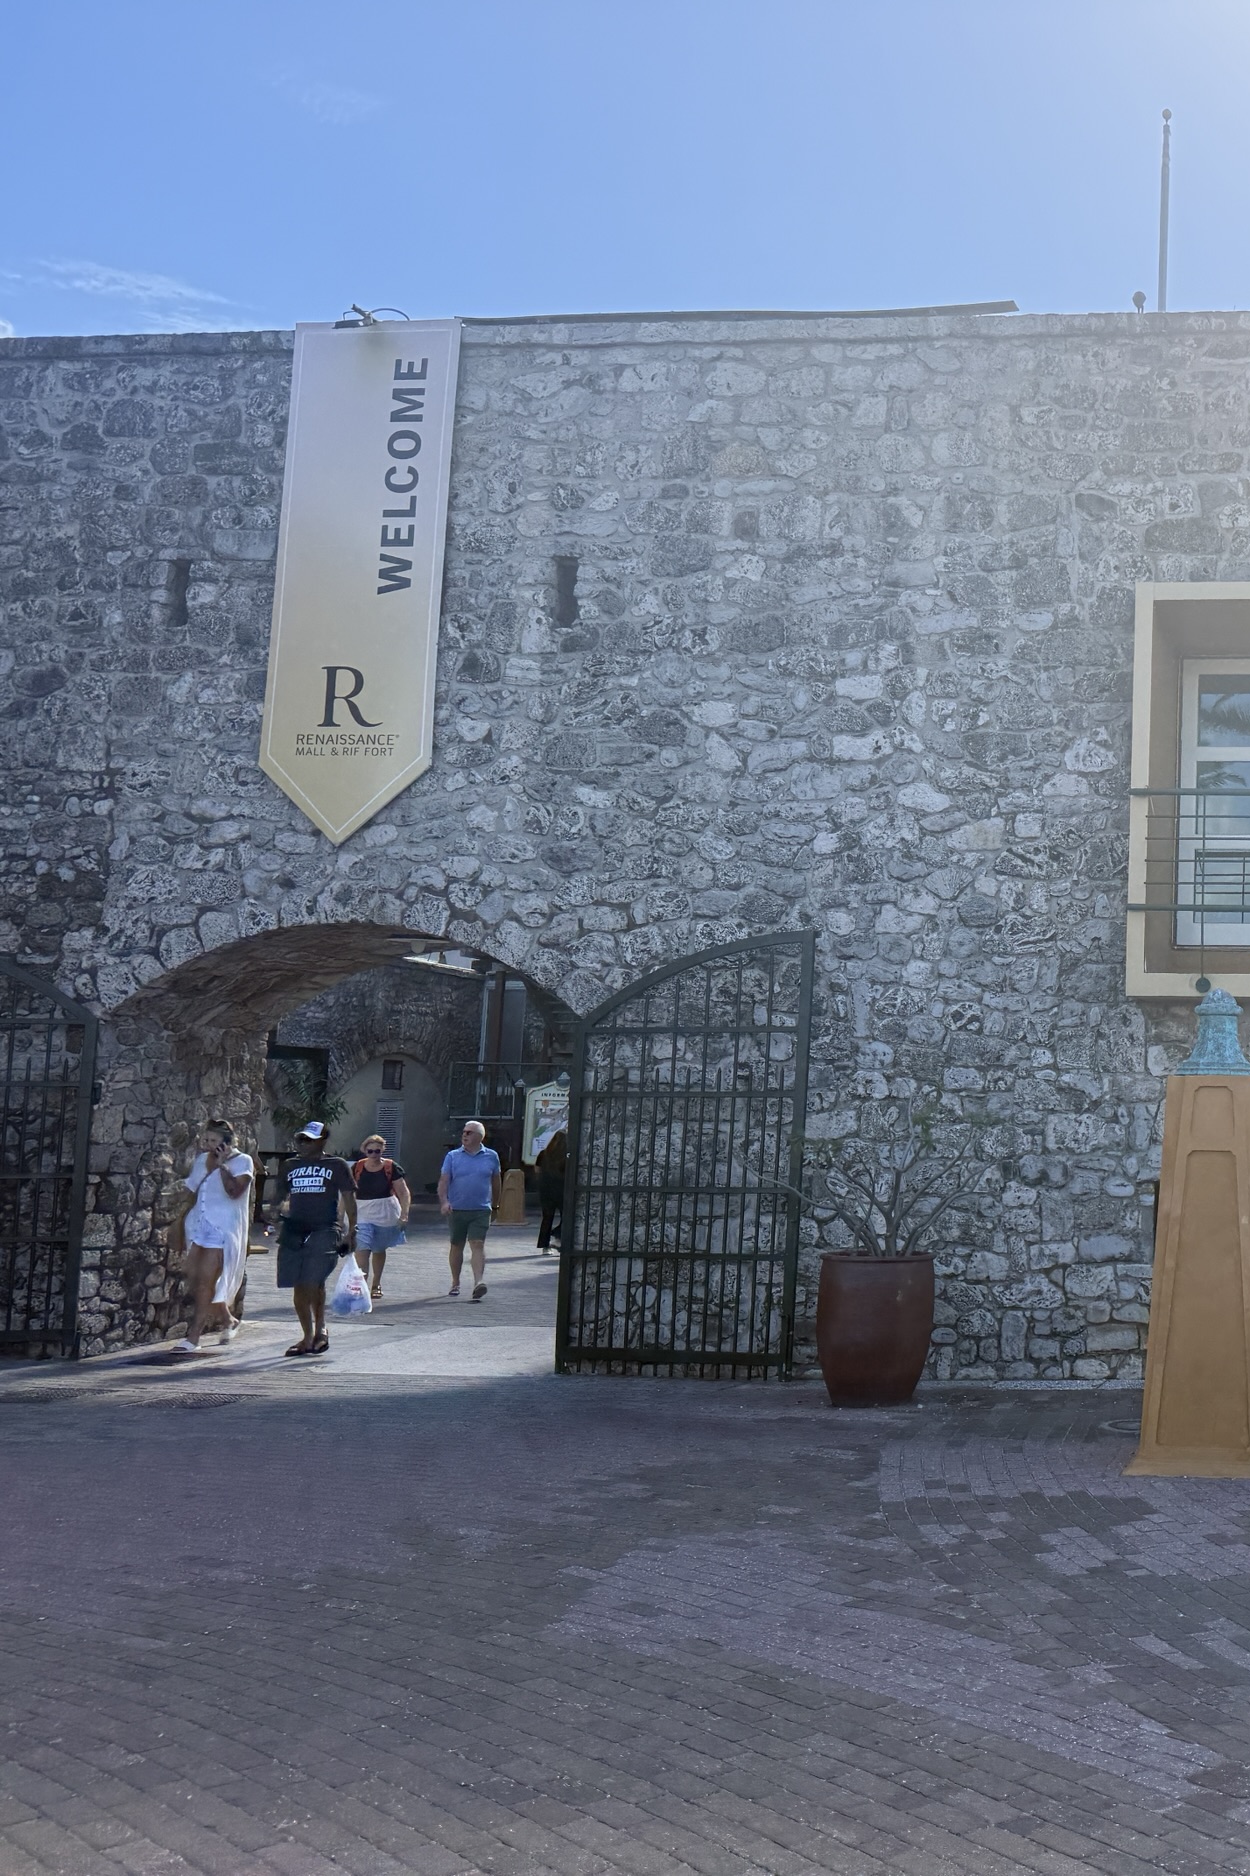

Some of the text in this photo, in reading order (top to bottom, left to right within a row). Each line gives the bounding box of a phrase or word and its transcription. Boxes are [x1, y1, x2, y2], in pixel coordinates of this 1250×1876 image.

[376, 357, 429, 596] WELCOME
[316, 665, 383, 728] R
[296, 733, 395, 746] RENAISSANCE
[295, 746, 394, 757] MALL & RIF FORT
[287, 1166, 333, 1181] CURAÇAO
